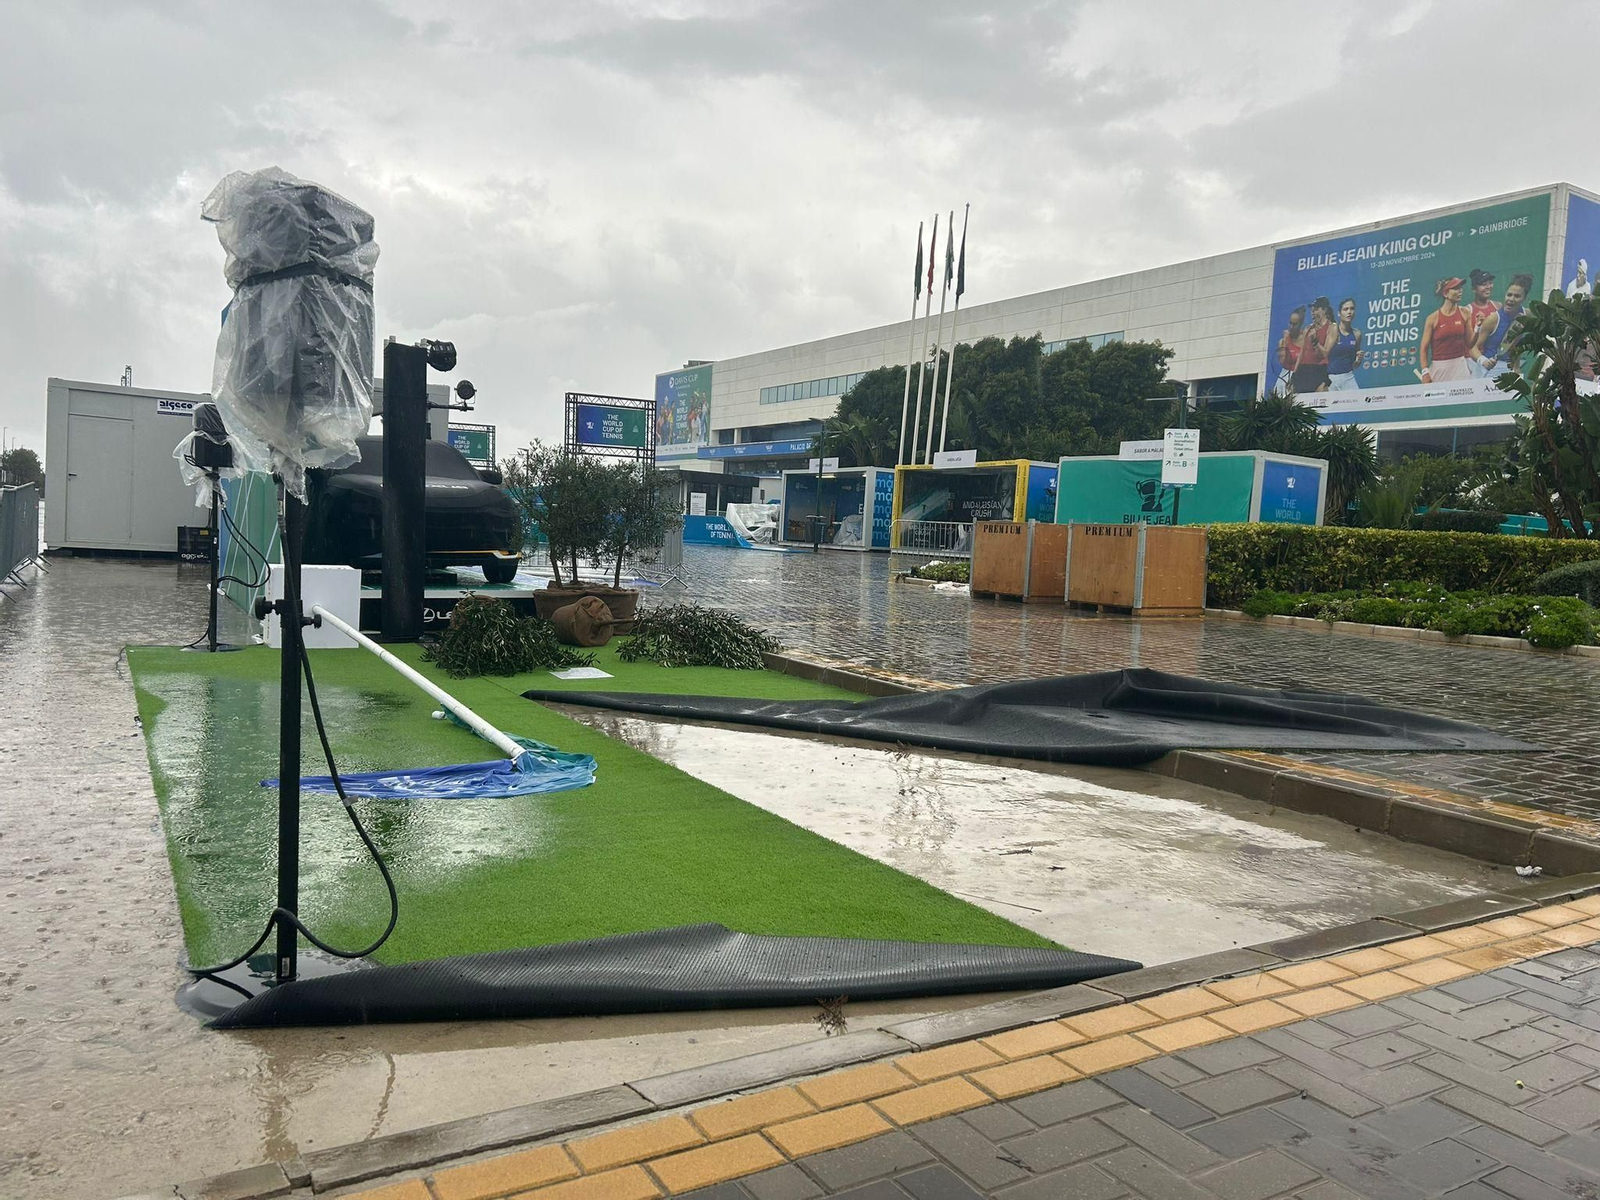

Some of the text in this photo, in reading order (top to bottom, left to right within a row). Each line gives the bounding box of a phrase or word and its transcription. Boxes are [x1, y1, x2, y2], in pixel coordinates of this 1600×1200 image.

[1297, 252, 1338, 271] BILLIE
[1338, 244, 1377, 264] JEAN
[1379, 237, 1417, 257] KING
[1419, 230, 1453, 248] CUP
[1478, 216, 1529, 235] GAINBRIDGE
[1370, 251, 1436, 269] 13-20 NOVIEMBRE 2024
[1381, 278, 1411, 296] THE
[1368, 293, 1421, 314] WORLD
[1367, 310, 1420, 330] CUP OF
[1364, 326, 1419, 346] TENNIS
[675, 373, 699, 385] DAVIS CUP
[159, 400, 193, 411] algeco
[602, 432, 624, 440] TENNIS
[789, 443, 805, 451] PALACIO
[1282, 498, 1297, 509] THE
[1153, 515, 1171, 525] JEA
[1275, 508, 1301, 520] WORLD
[983, 524, 1021, 534] PREMIUM
[1085, 526, 1133, 537] PREMIUM
